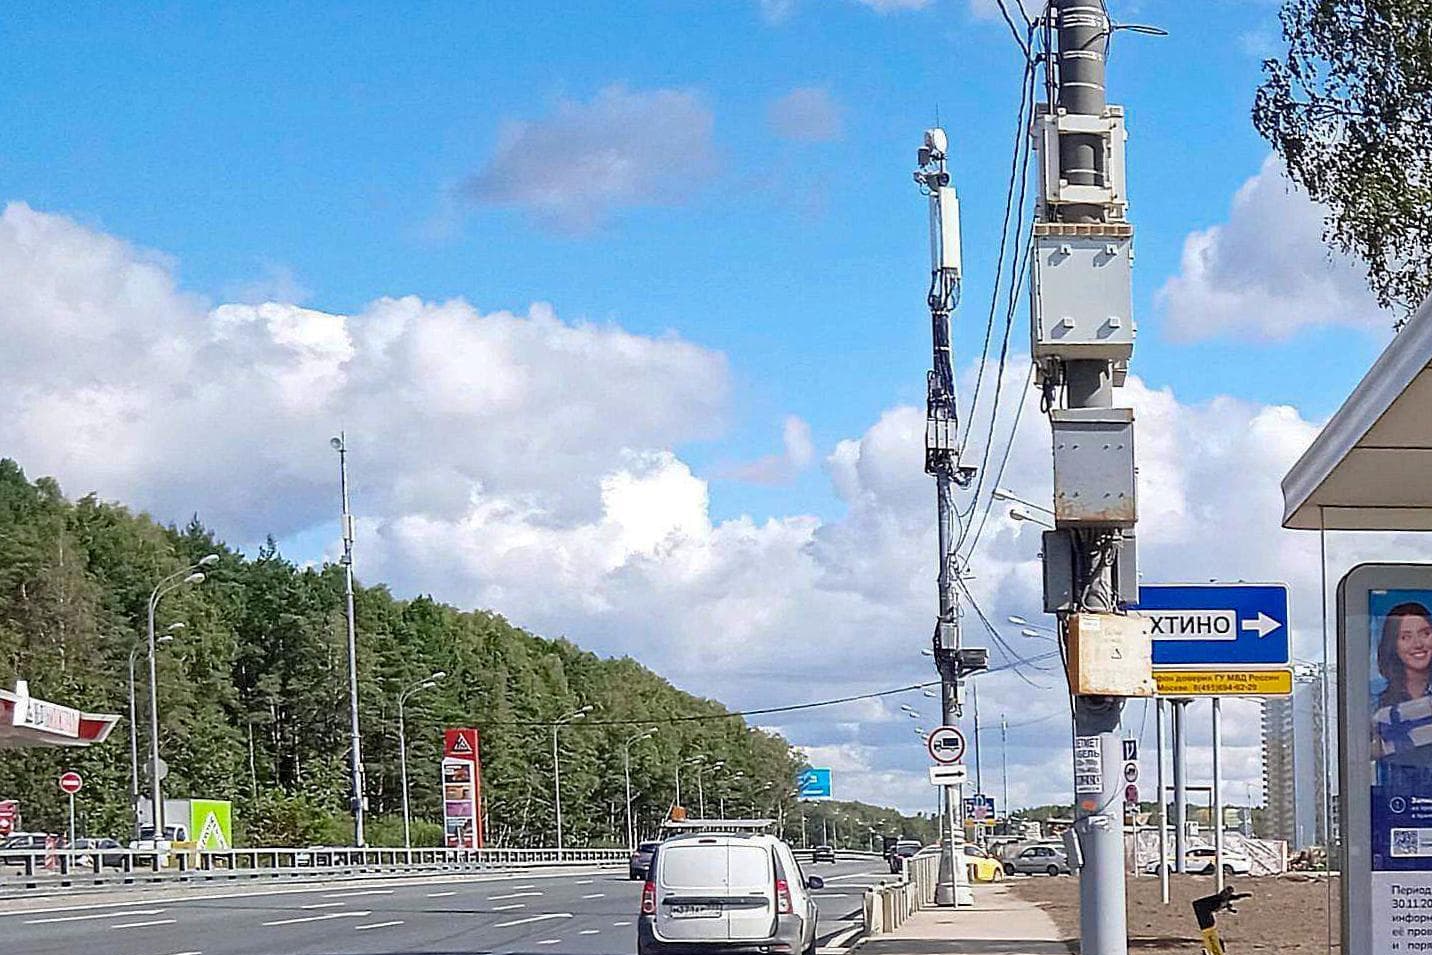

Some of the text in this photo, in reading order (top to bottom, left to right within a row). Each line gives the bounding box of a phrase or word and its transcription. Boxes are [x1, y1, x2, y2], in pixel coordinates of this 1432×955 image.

[1150, 616, 1231, 634] ХТИНО
[1227, 674, 1247, 683] МВД
[1392, 885, 1432, 895] Период
